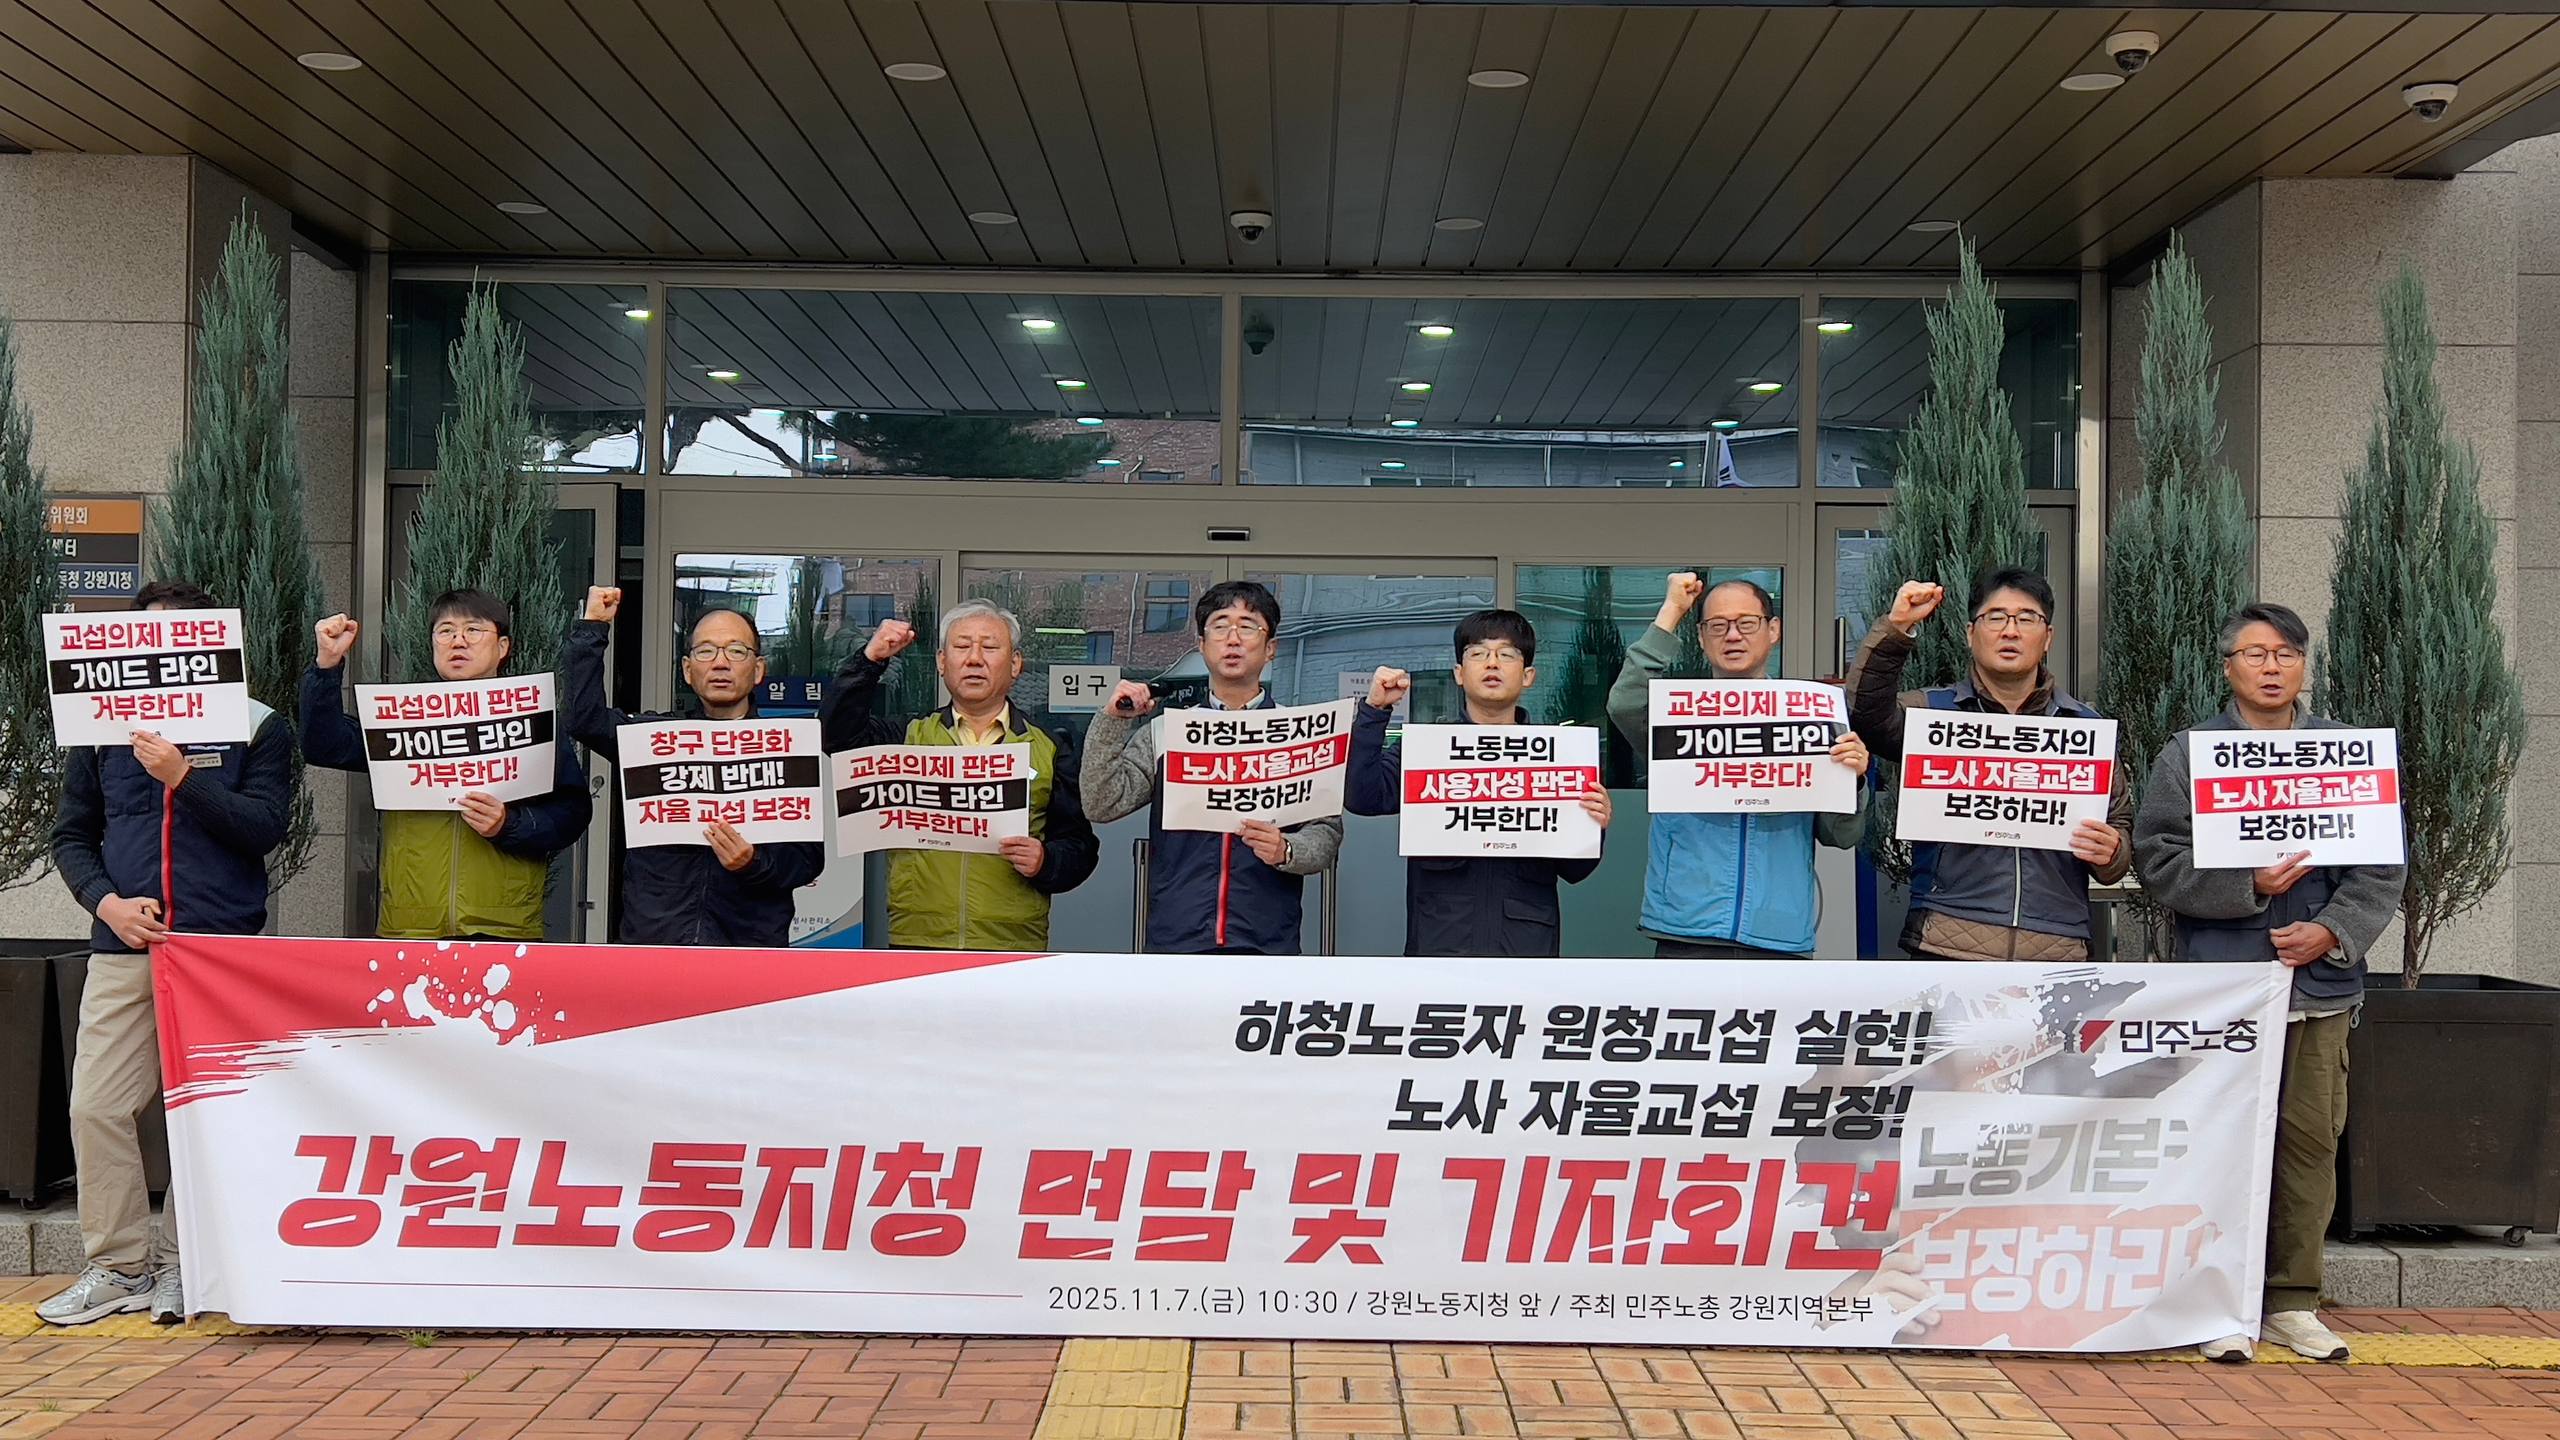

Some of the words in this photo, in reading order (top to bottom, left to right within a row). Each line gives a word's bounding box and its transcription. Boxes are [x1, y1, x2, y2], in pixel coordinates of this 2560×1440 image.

[83, 570, 132, 590] 강원지청
[60, 622, 163, 650] 교섭의제
[170, 620, 226, 647] 판단
[71, 659, 150, 690] 가이드
[159, 654, 219, 683] 라인
[90, 693, 204, 721] 거부한다!
[374, 691, 480, 720] 교섭의제
[486, 685, 541, 715] 판단
[1667, 691, 1776, 717] 교섭의제
[1785, 691, 1835, 718] 판단
[386, 728, 470, 757] 가이드
[477, 718, 532, 751] 라인
[650, 730, 704, 756] 창구
[711, 728, 792, 756] 단일화
[1185, 711, 1336, 746] 하청노동자의
[1676, 727, 1763, 756] 가이드
[1773, 724, 1830, 753] 라인
[1928, 721, 2096, 756] 하청노동자의
[1182, 756, 1237, 782] 노사
[1242, 740, 1335, 780] 자율교섭
[1449, 736, 1555, 762] 노동부의
[2213, 740, 2374, 768] 하청노동자의
[408, 757, 518, 787] 거부한다!
[659, 764, 714, 792] 강제
[721, 761, 785, 791] 반대!
[850, 753, 954, 778] 교섭의제
[962, 753, 1015, 778] 판단
[1695, 762, 1812, 788] 거부한다!
[1921, 759, 1978, 787] 노사
[1983, 761, 2095, 791] 자율교섭
[859, 783, 941, 808] 가이드
[951, 784, 1004, 809] 라인
[1206, 780, 1312, 812] 보장하라!
[1420, 771, 1525, 800] 사용자성
[1531, 770, 1585, 798] 판단
[2212, 779, 2267, 809] 노사
[2271, 774, 2379, 806] 자율교섭
[639, 798, 691, 824] 자율
[697, 800, 745, 824] 교섭
[752, 797, 811, 821] 보장!
[879, 810, 988, 838] 거부한다!
[1444, 806, 1558, 832] 거부한다!
[1944, 793, 2067, 826] 보장하라!
[2239, 813, 2355, 841] 보장하라!
[1235, 1000, 1526, 1059] 하청노동자
[1542, 1004, 1777, 1064] 원청교섭
[1794, 1008, 1933, 1066] 실현!
[2119, 1018, 2258, 1054] 민주노총
[1387, 1079, 1507, 1135] 노사
[1518, 1079, 1760, 1138] 자율교섭
[1771, 1085, 1914, 1141] 보장!
[277, 1134, 983, 1256] 강원노동지청
[1017, 1148, 1256, 1262] 면담
[1284, 1152, 1400, 1264] 및
[1442, 1153, 1901, 1270] 기자회견
[1048, 1285, 1245, 1315] 2025.11.7.(금)
[1258, 1289, 1337, 1315] 10:30
[1346, 1290, 1358, 1315] /
[1366, 1290, 1508, 1317] 강원노동지청
[1518, 1292, 1541, 1318] 앞
[1549, 1294, 1560, 1316] /
[1569, 1294, 1616, 1319] 주최
[1625, 1294, 1719, 1320] 민주노총
[1729, 1295, 1874, 1323] 강원지역본부
